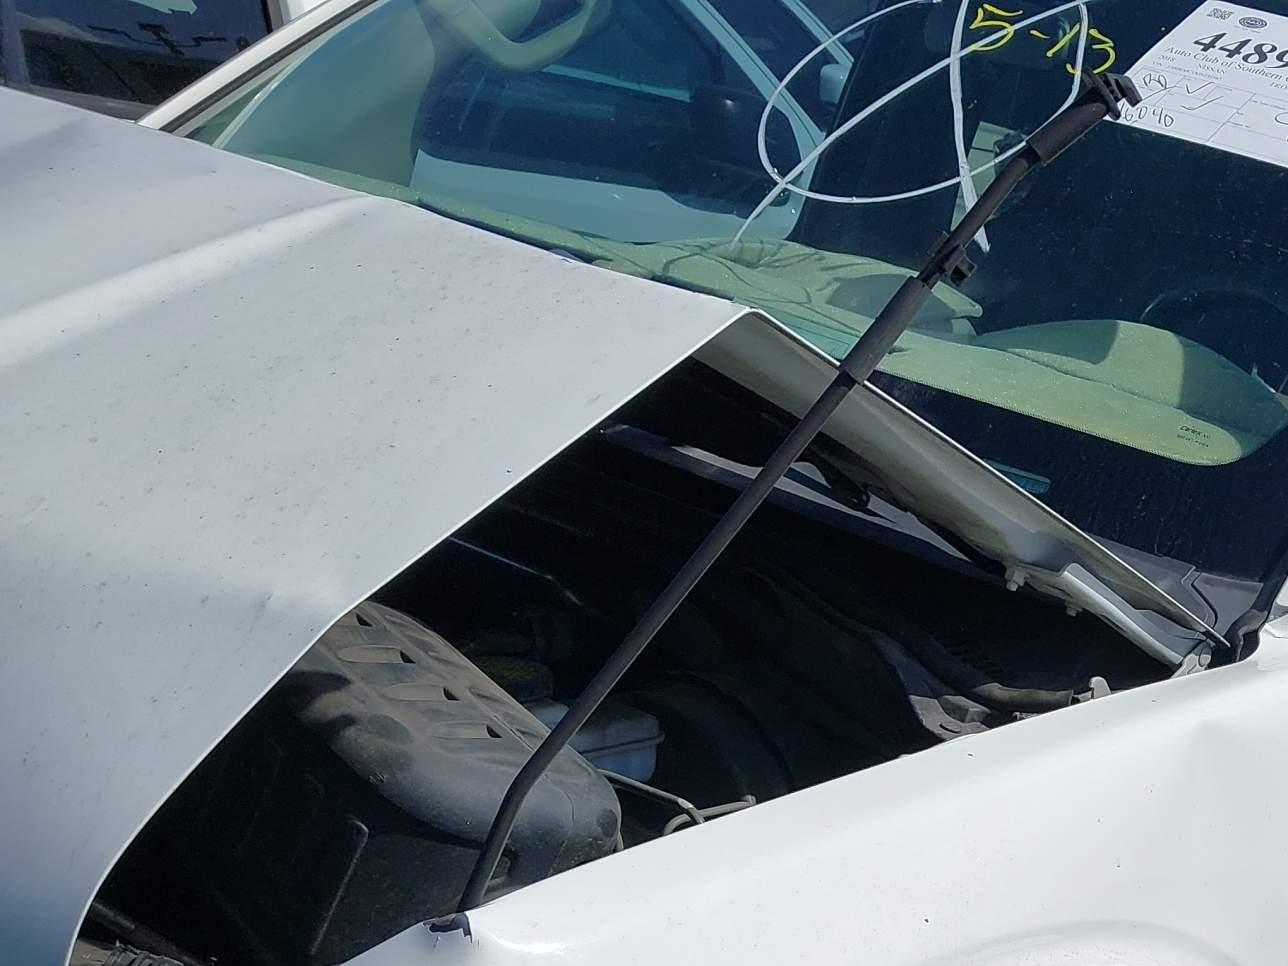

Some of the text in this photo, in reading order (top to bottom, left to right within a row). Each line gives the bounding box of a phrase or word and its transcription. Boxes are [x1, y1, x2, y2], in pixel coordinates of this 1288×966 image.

[1164, 47, 1192, 57] Auto
[1193, 53, 1220, 64] Club
[1220, 60, 1234, 69] of
[1234, 61, 1284, 81] Southern
